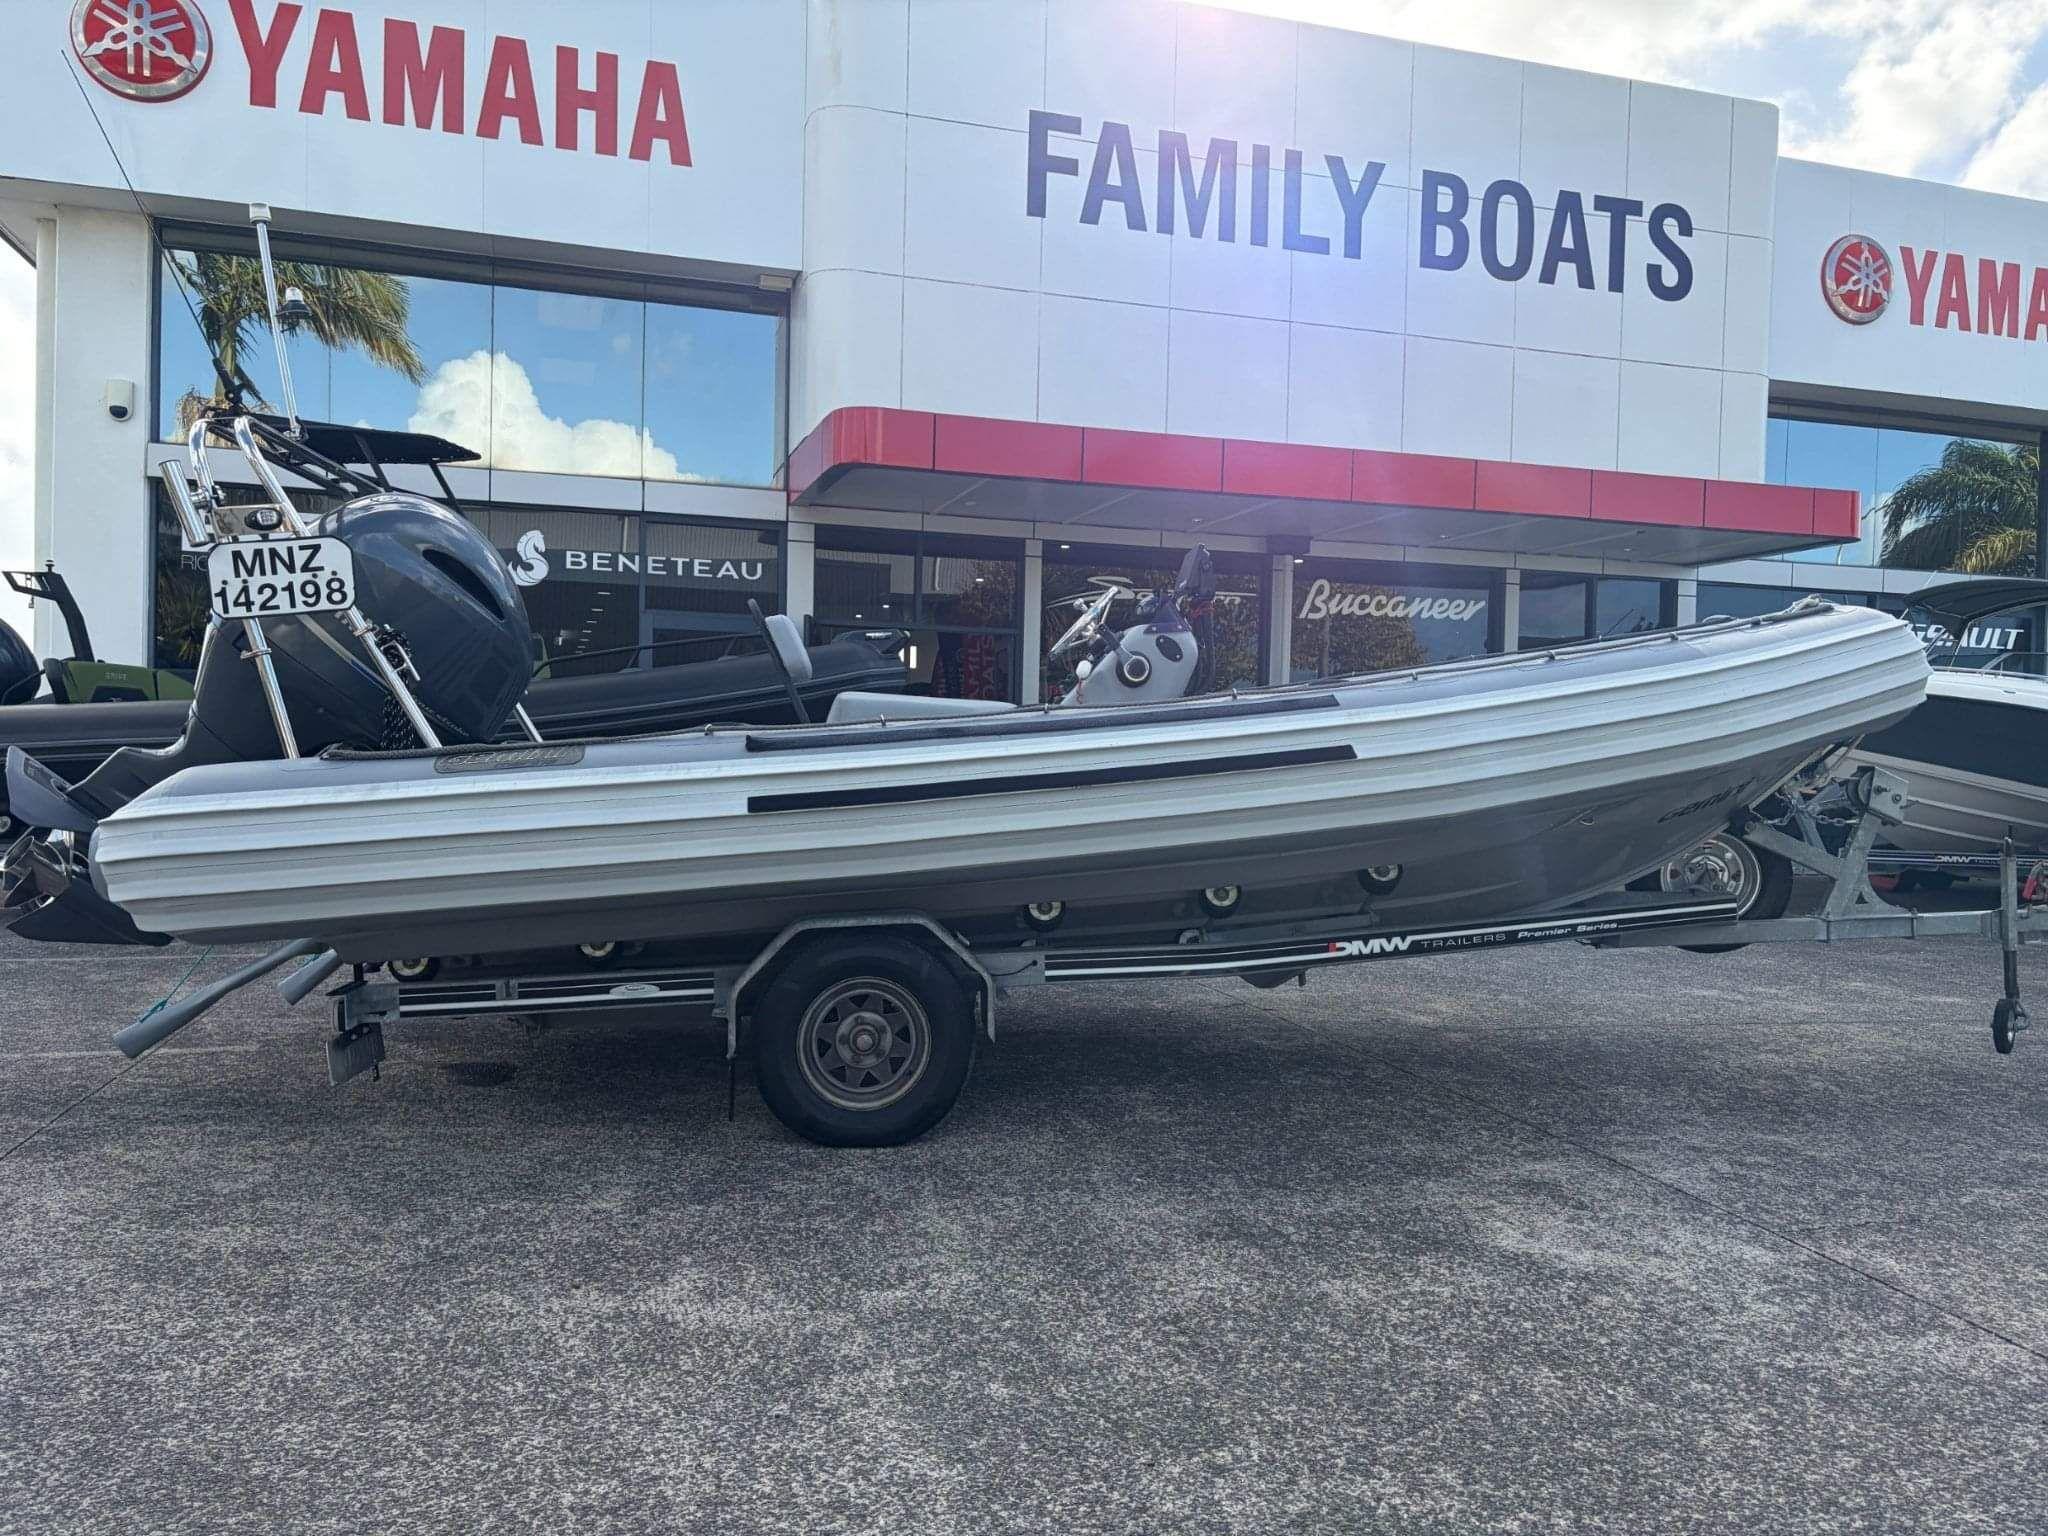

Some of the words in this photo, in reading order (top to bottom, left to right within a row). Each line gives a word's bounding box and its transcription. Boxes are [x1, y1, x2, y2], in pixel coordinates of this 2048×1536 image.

[228, 0, 692, 167] YAMAHA
[1026, 109, 1386, 260] FAMILY
[1419, 169, 1694, 302] BOATS
[231, 543, 325, 578] MNZ
[565, 550, 763, 580] BENETEAU
[214, 577, 348, 614] 142198
[1296, 578, 1487, 621] Buccaneer
[1328, 935, 1413, 956] DMW
[1421, 933, 1507, 949] TRAILERS
[1517, 926, 1571, 939] Premier
[1576, 921, 1618, 932] Series
